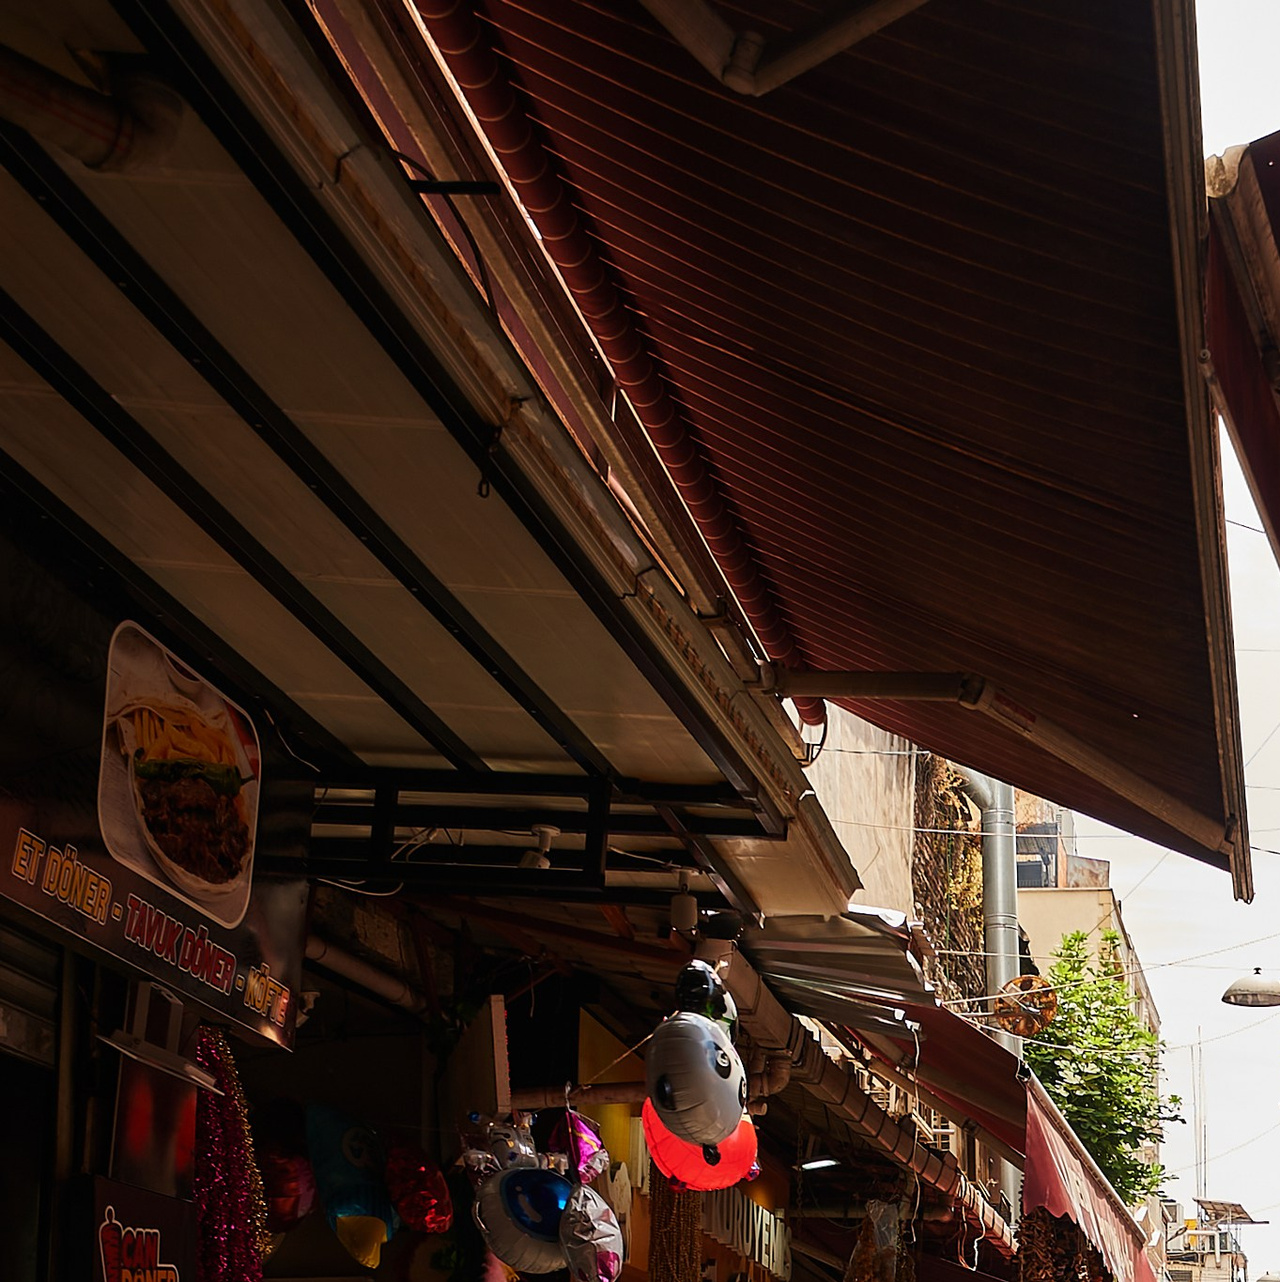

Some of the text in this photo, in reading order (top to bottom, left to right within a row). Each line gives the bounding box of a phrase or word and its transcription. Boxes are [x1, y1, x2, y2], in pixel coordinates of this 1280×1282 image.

[12, 827, 46, 885] ET
[42, 843, 112, 925] DÖNER
[124, 893, 184, 966] TAVUK
[178, 925, 236, 996] DÖNER
[243, 962, 291, 1028] KÖFTE
[121, 1230, 158, 1268] CAN
